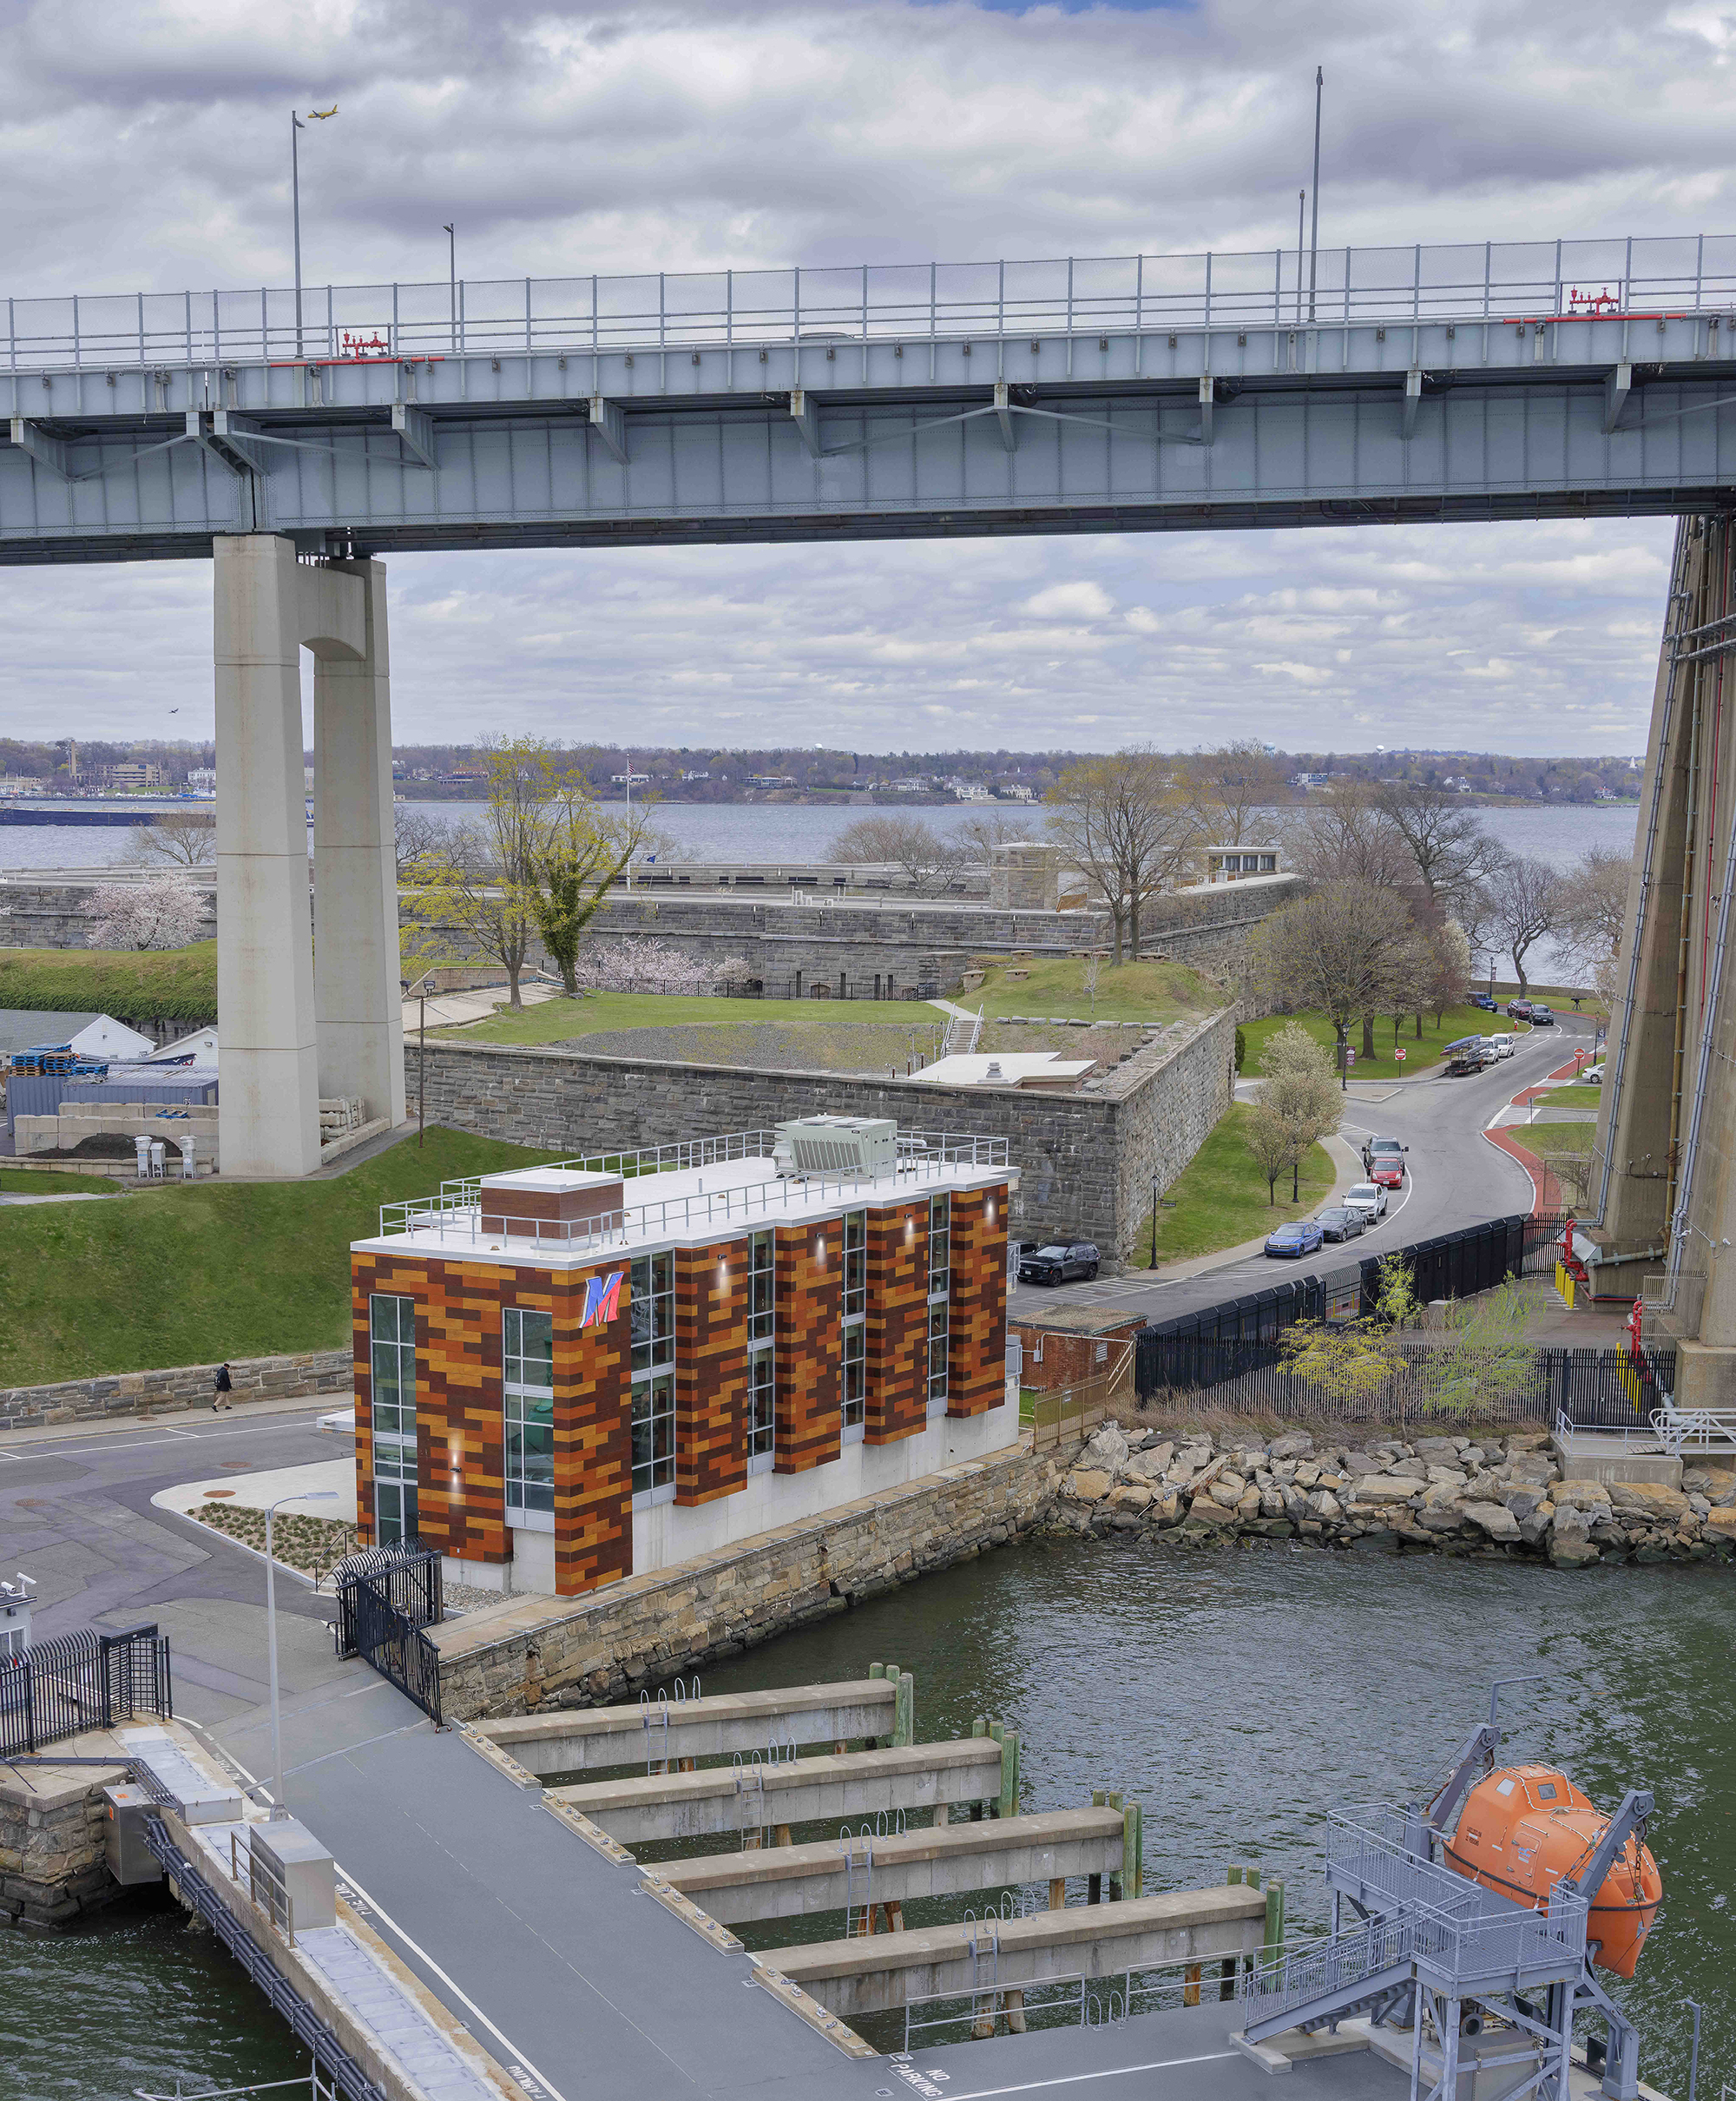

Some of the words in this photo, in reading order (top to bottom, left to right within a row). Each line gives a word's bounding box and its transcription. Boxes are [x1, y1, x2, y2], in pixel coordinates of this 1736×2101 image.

[579, 1271, 624, 1329] M
[891, 2064, 944, 2097] PARKING
[925, 2069, 950, 2081] NO
